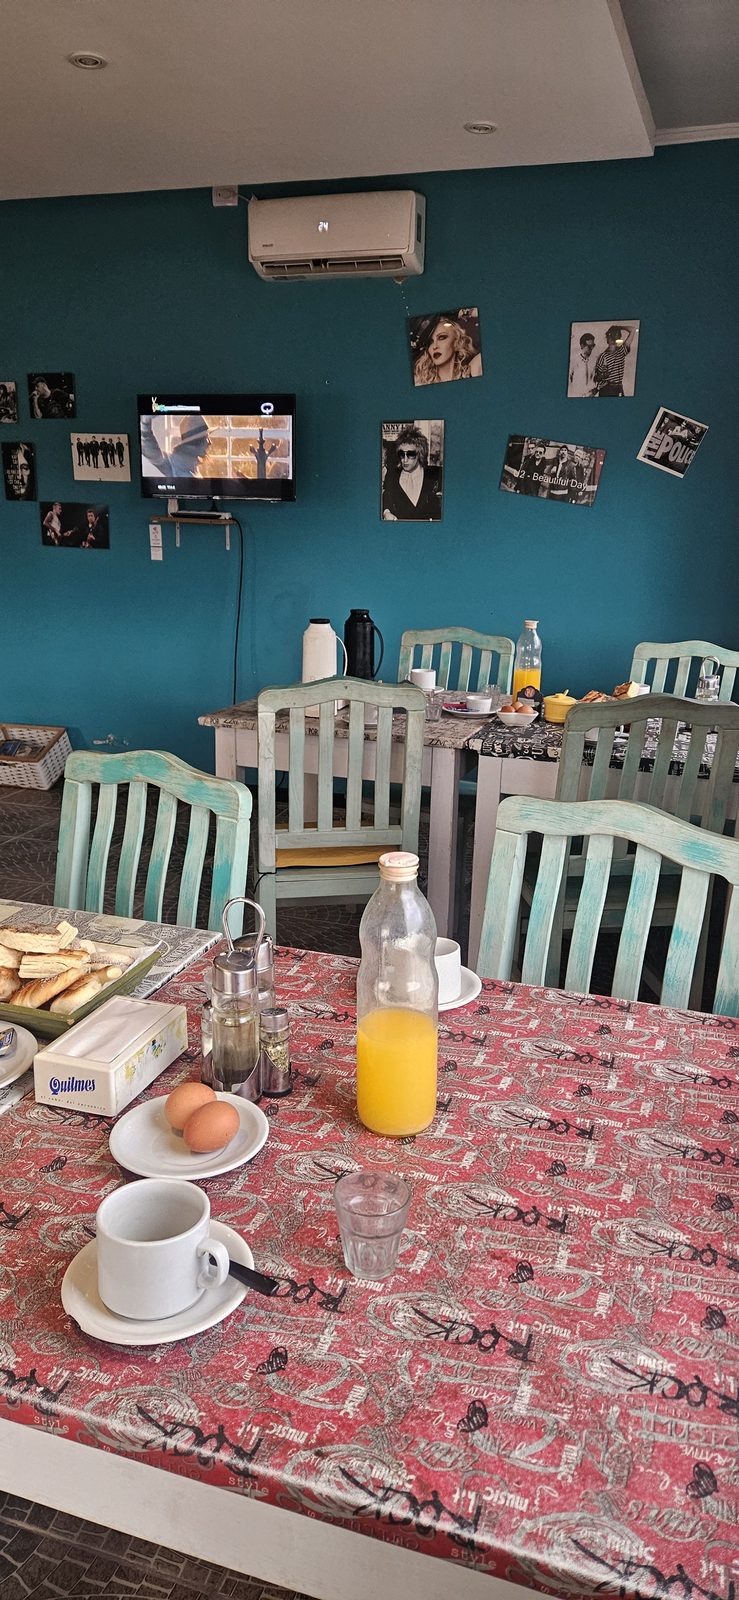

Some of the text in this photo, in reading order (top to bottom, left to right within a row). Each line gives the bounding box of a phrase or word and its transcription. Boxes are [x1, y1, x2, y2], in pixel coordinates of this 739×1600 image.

[532, 472, 570, 486] Beautiful
[570, 480, 588, 492] Day
[50, 1076, 96, 1095] Quilmes
[501, 1109, 593, 1139] ROCK
[592, 1117, 623, 1128] music
[486, 1191, 518, 1205] music
[463, 1193, 567, 1232] ROCK
[545, 1203, 602, 1217] music hit
[656, 1228, 691, 1243] music
[259, 1261, 296, 1277] music
[274, 1277, 346, 1313] ROC
[436, 1304, 475, 1323] music
[410, 1306, 531, 1360] ROCK
[506, 1319, 572, 1340] music hit
[635, 1353, 676, 1375] music
[74, 1366, 113, 1386] music
[459, 1386, 510, 1405] CREATIVE
[34, 1416, 70, 1432] style
[236, 1421, 308, 1445] music hit
[679, 1446, 735, 1468] CREATIVE
[228, 1476, 269, 1494] style
[449, 1485, 530, 1515] music hit
[450, 1548, 497, 1570] style
